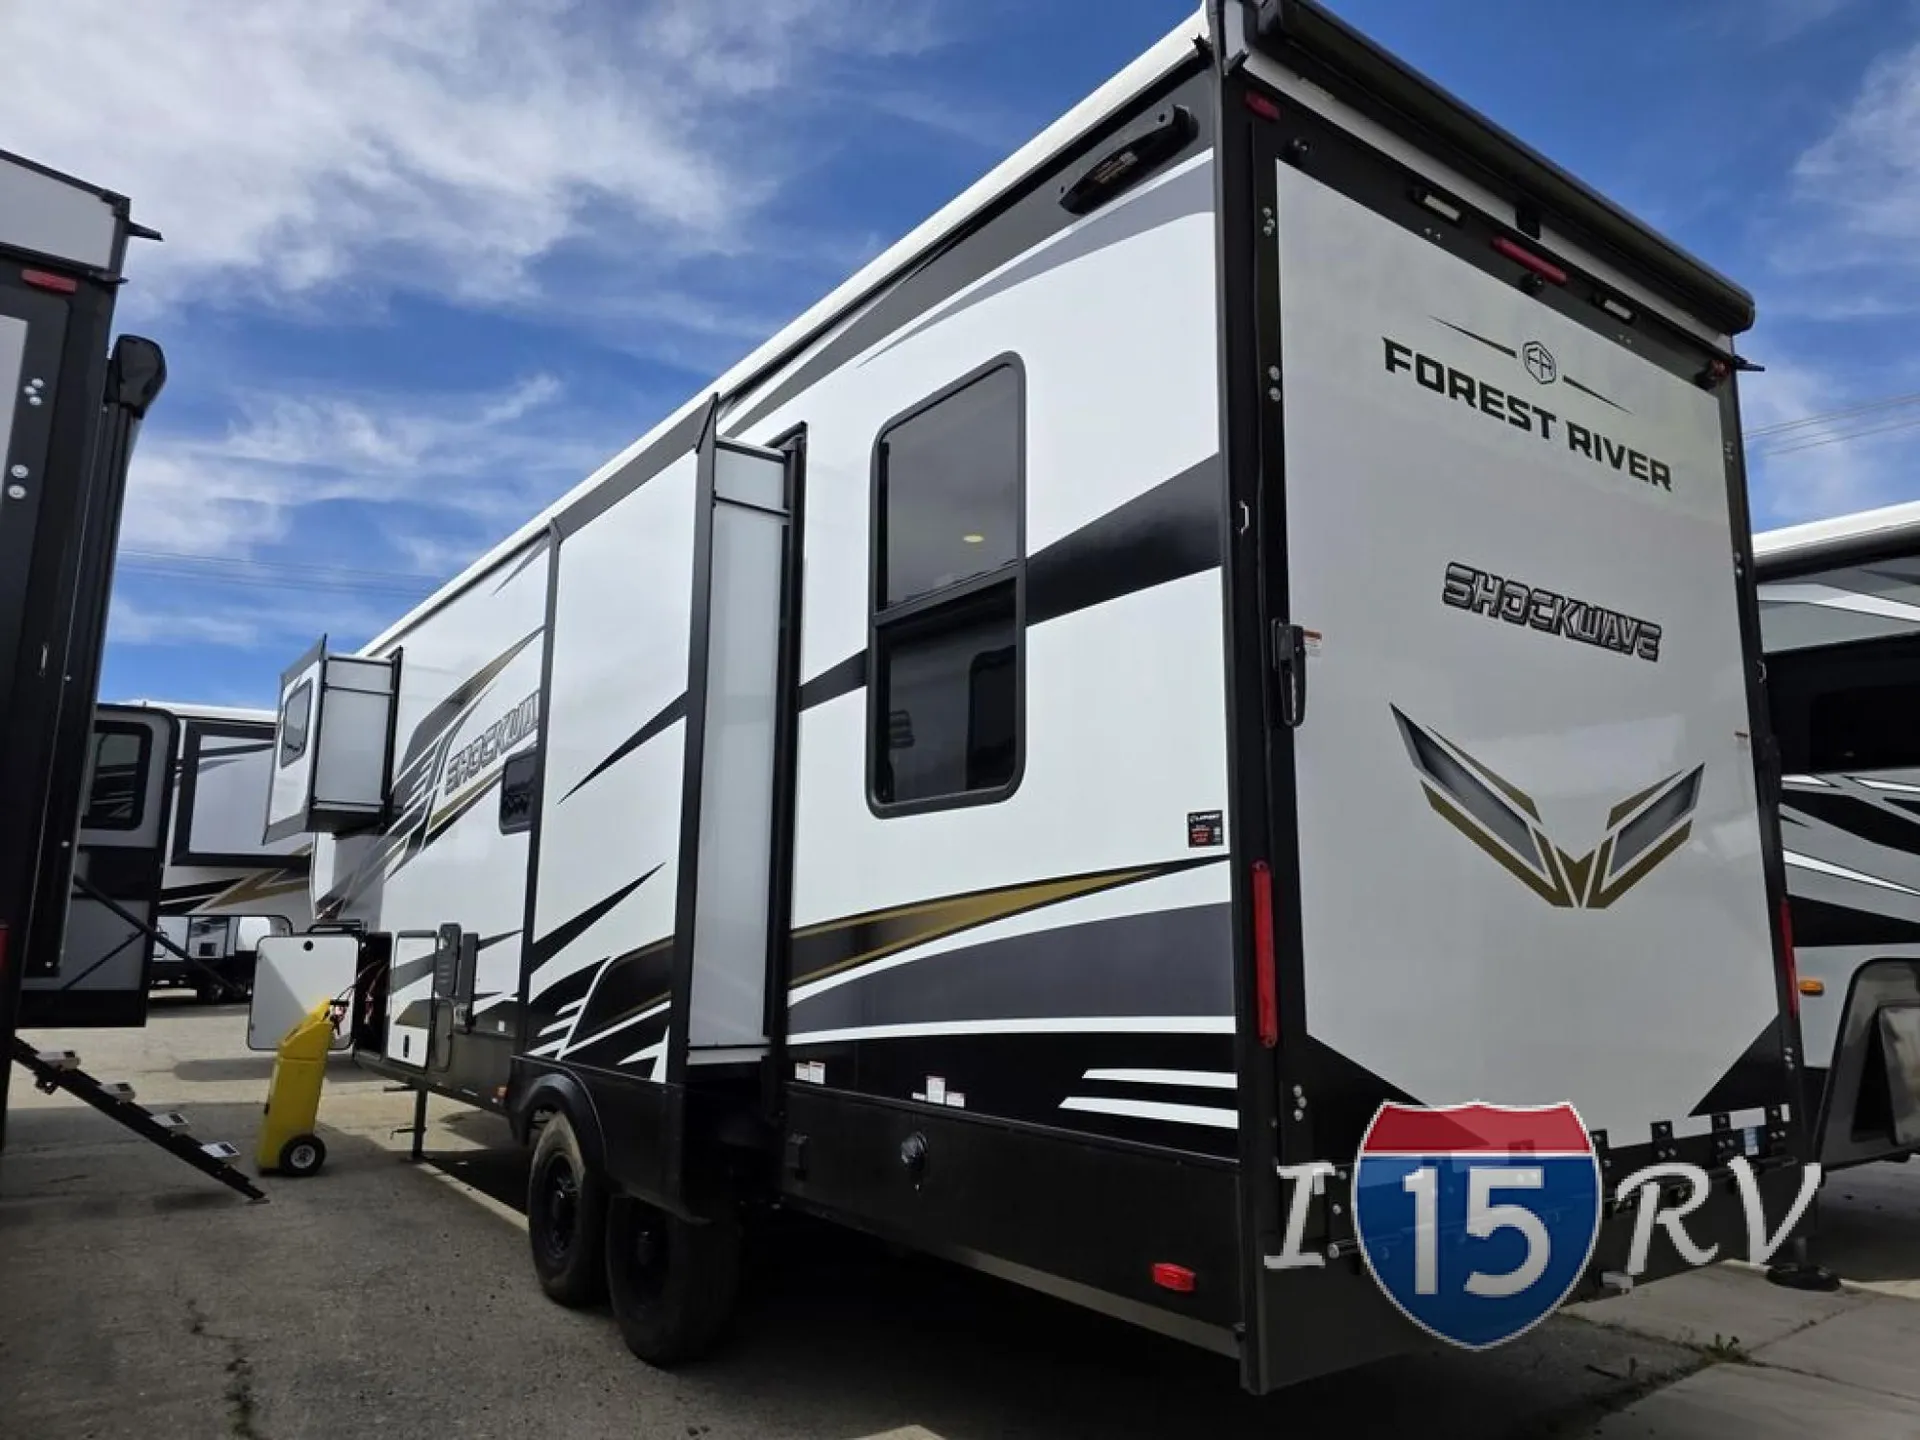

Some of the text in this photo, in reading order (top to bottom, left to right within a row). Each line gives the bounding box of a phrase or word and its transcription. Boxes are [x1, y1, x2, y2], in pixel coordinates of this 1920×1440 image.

[1382, 337, 1672, 492] FOREST RIVER
[1442, 562, 1662, 662] SHOCKWAVE
